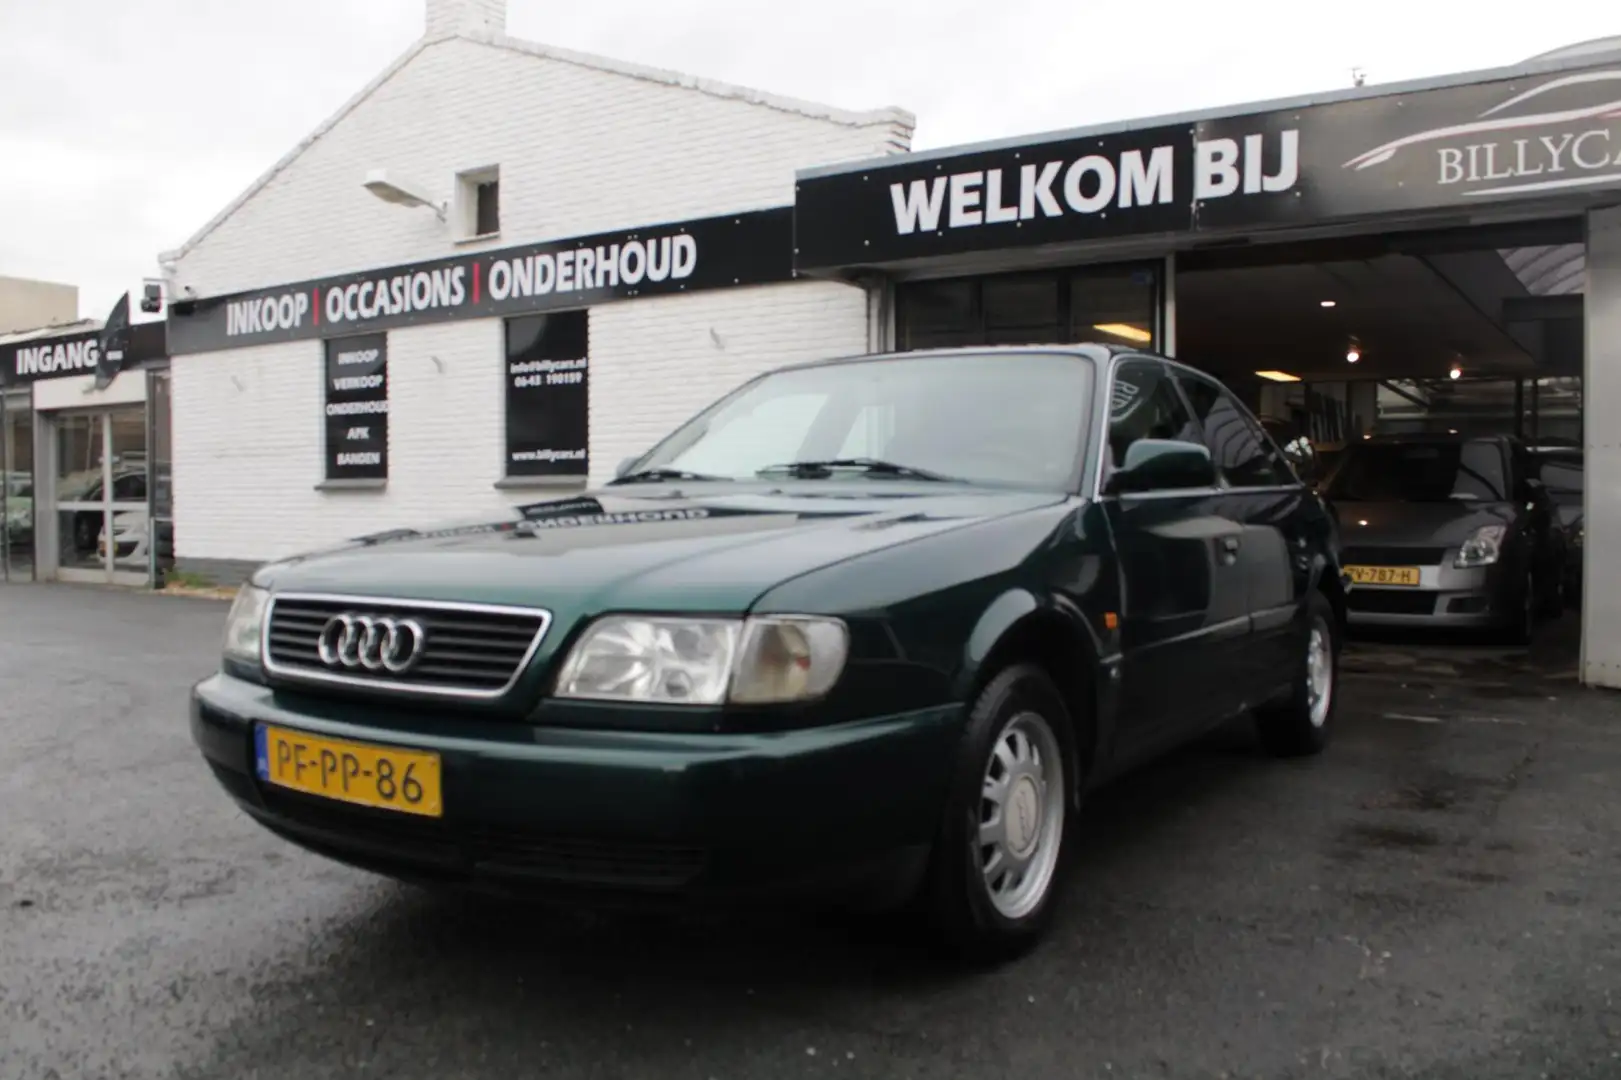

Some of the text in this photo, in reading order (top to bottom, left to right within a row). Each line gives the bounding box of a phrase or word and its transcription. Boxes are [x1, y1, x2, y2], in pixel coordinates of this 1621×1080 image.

[1436, 128, 1621, 185] BILLYC
[889, 129, 1299, 235] WELKOM BIJ
[226, 234, 697, 336] INKOOP OCCASIONS ONDERHOUD
[16, 339, 99, 375] INGANG
[338, 349, 379, 365] INKOOP
[333, 374, 383, 390] VERKOOP
[346, 426, 370, 440] APK
[337, 452, 381, 465] BANDEN
[277, 739, 424, 804] PF-PP-86
